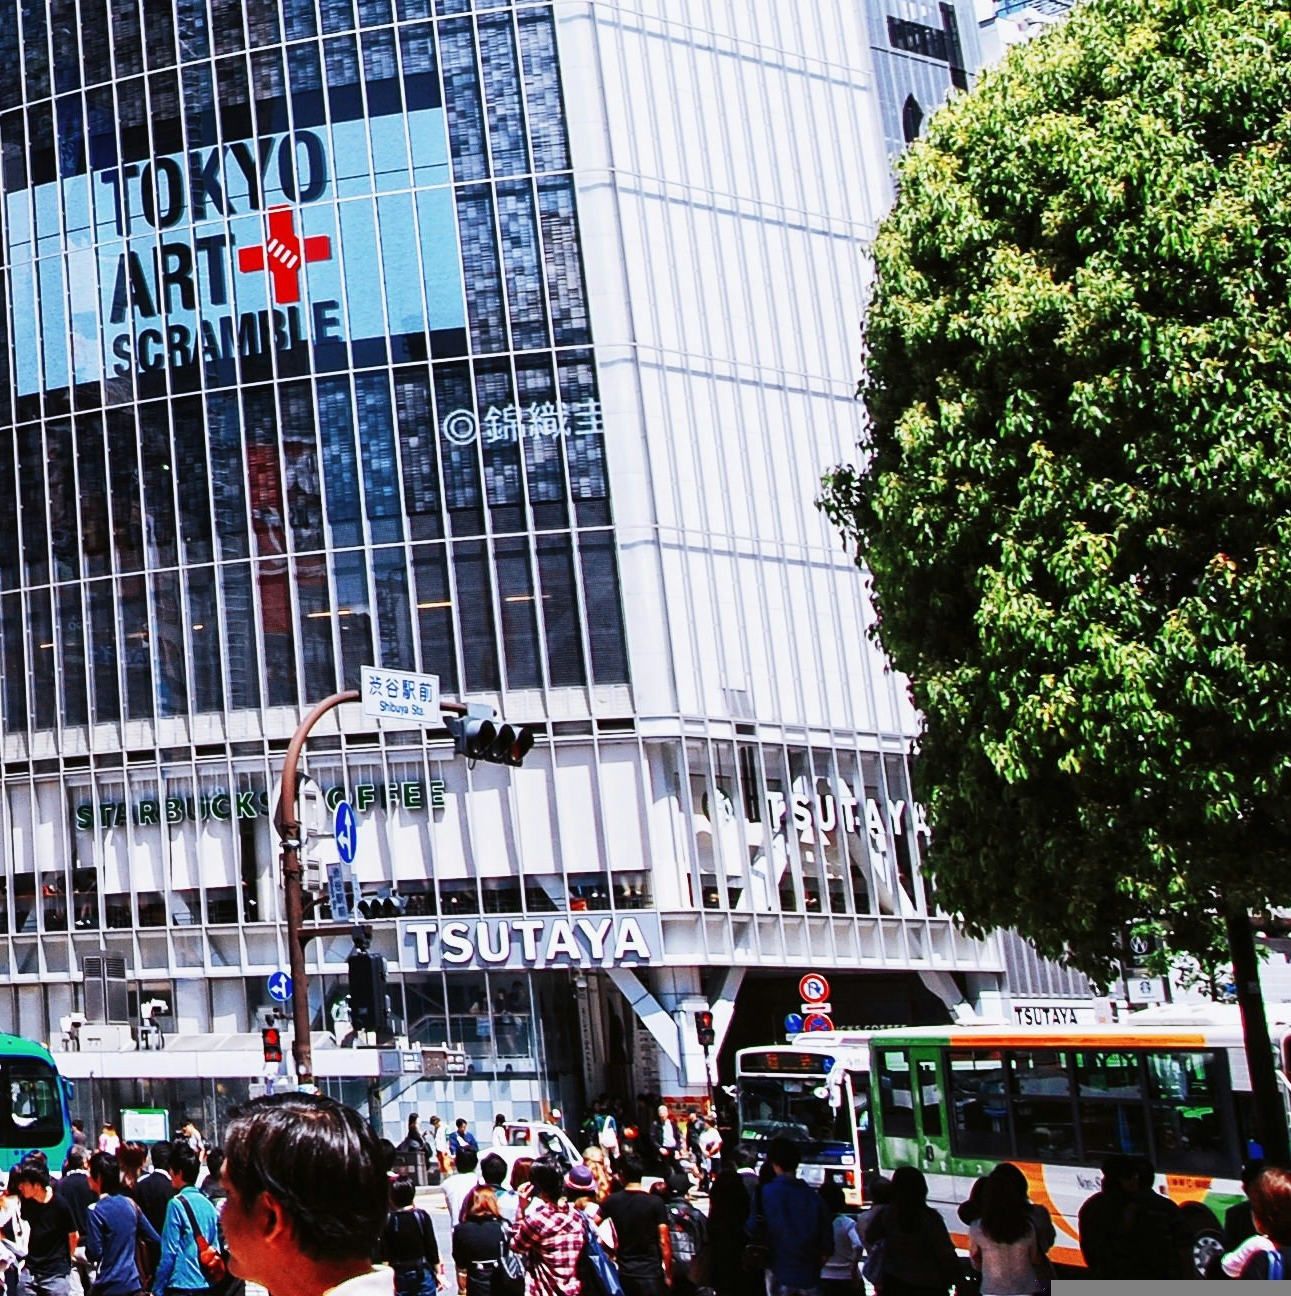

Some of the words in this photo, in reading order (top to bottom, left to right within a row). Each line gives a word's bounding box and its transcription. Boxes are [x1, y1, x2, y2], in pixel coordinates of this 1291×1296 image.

[100, 129, 329, 238] TOKYO
[109, 231, 236, 325] ART
[111, 299, 342, 377] SCRAMBLE
[368, 675, 434, 703] 渋谷駅前
[379, 700, 410, 716] Shibuya
[767, 790, 931, 837] TSUTAYA
[403, 916, 652, 966] TSUTAYA
[1014, 1006, 1078, 1026] TSUTAYA
